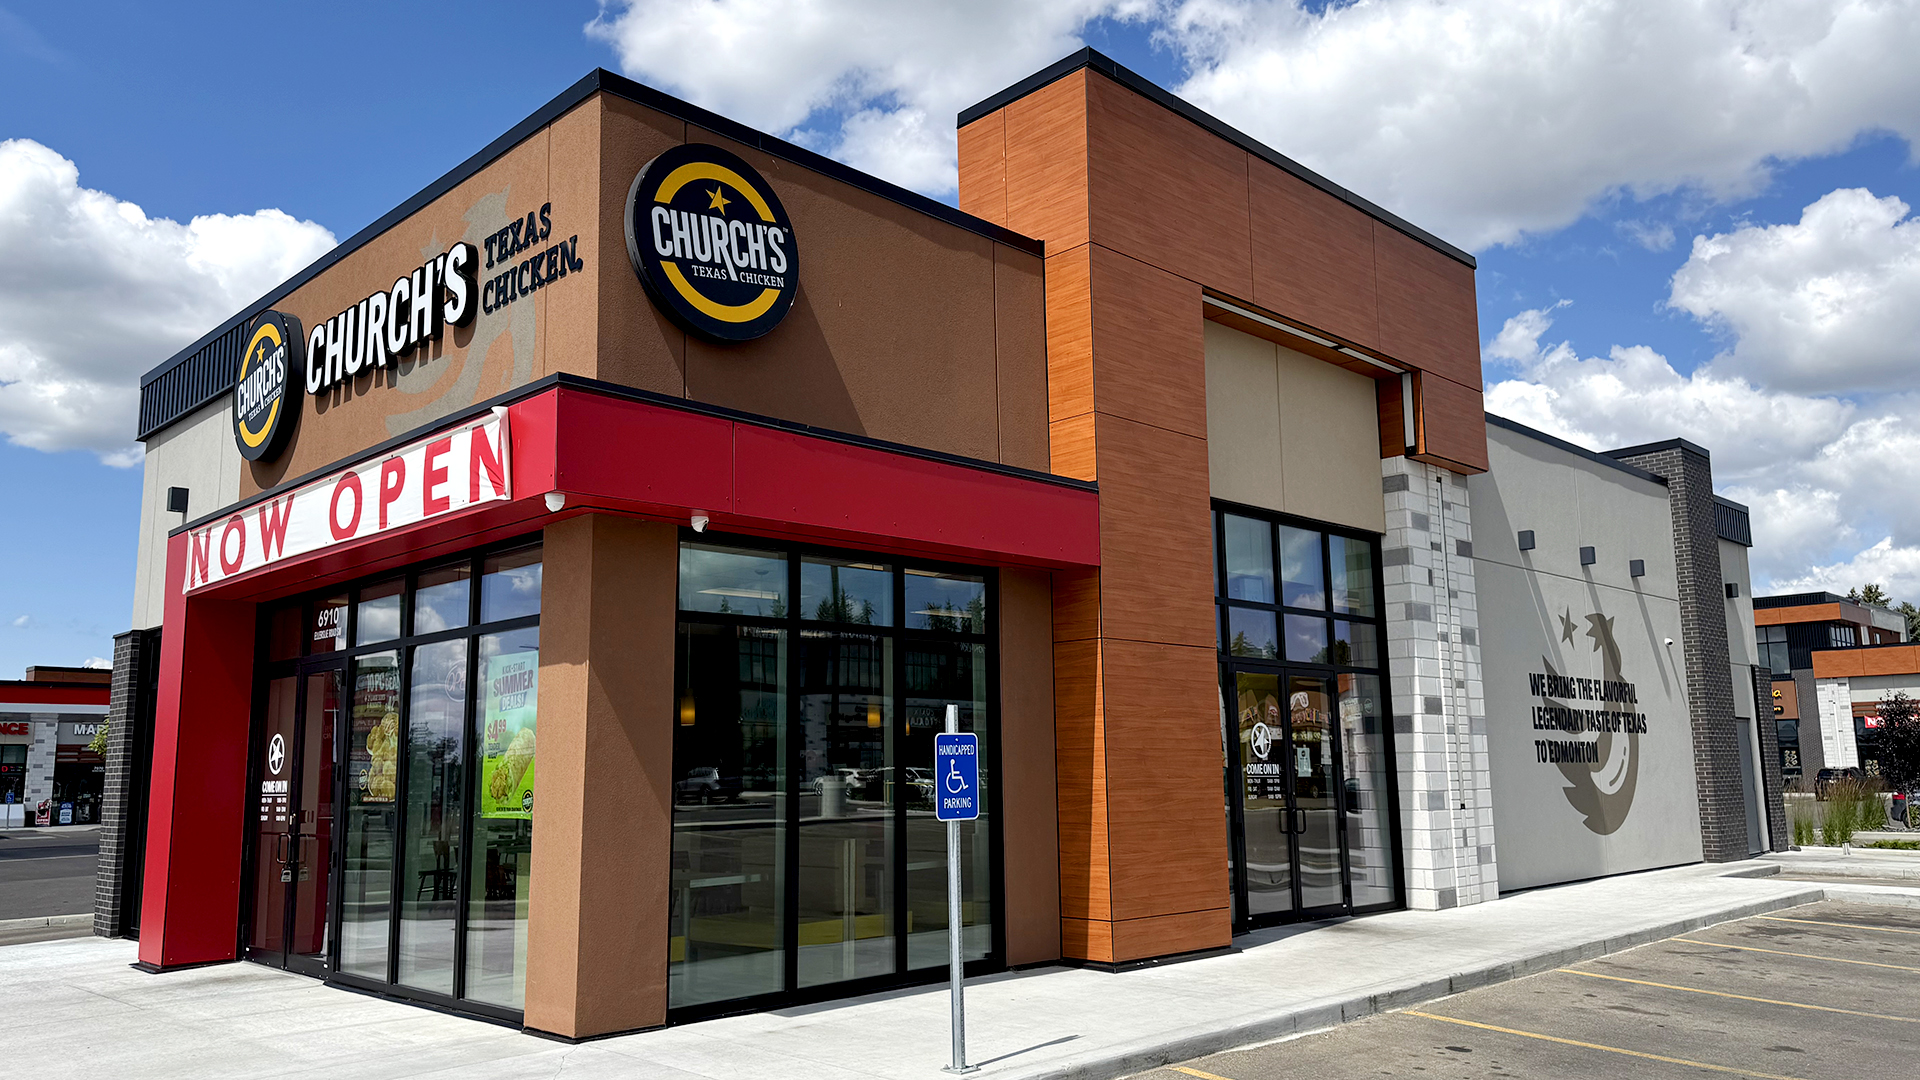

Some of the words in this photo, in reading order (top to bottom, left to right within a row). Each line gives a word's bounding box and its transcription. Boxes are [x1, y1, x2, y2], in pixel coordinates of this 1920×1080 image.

[484, 202, 551, 270] TEXAS
[652, 206, 787, 281] CHURCH'S
[692, 265, 727, 280] TEXAS
[740, 271, 784, 288] CHICKEN
[305, 241, 469, 395] CHURCH'S
[237, 346, 284, 419] CHURCH'S
[190, 493, 295, 588] NOW
[329, 424, 506, 542] OPEN
[318, 607, 340, 628] 6910
[493, 669, 534, 697] SUMMER
[1528, 672, 1546, 697] WE
[1546, 673, 1576, 699] BRING
[1576, 677, 1594, 700] THE
[1594, 679, 1638, 704] FLAVORFUL
[501, 692, 525, 711] DEALS!
[1531, 706, 1584, 732] LEGENDARY
[1585, 709, 1611, 733] TASTE
[1611, 710, 1622, 733] OF
[1621, 712, 1647, 734] TEXAS
[938, 744, 975, 756] HANDICAPPED
[1534, 740, 1547, 763] TO
[1548, 740, 1599, 764] EDMONTON
[1246, 763, 1263, 775] COME
[1263, 763, 1272, 775] ON
[1272, 763, 1280, 775] IN
[943, 797, 972, 809] PARKING
